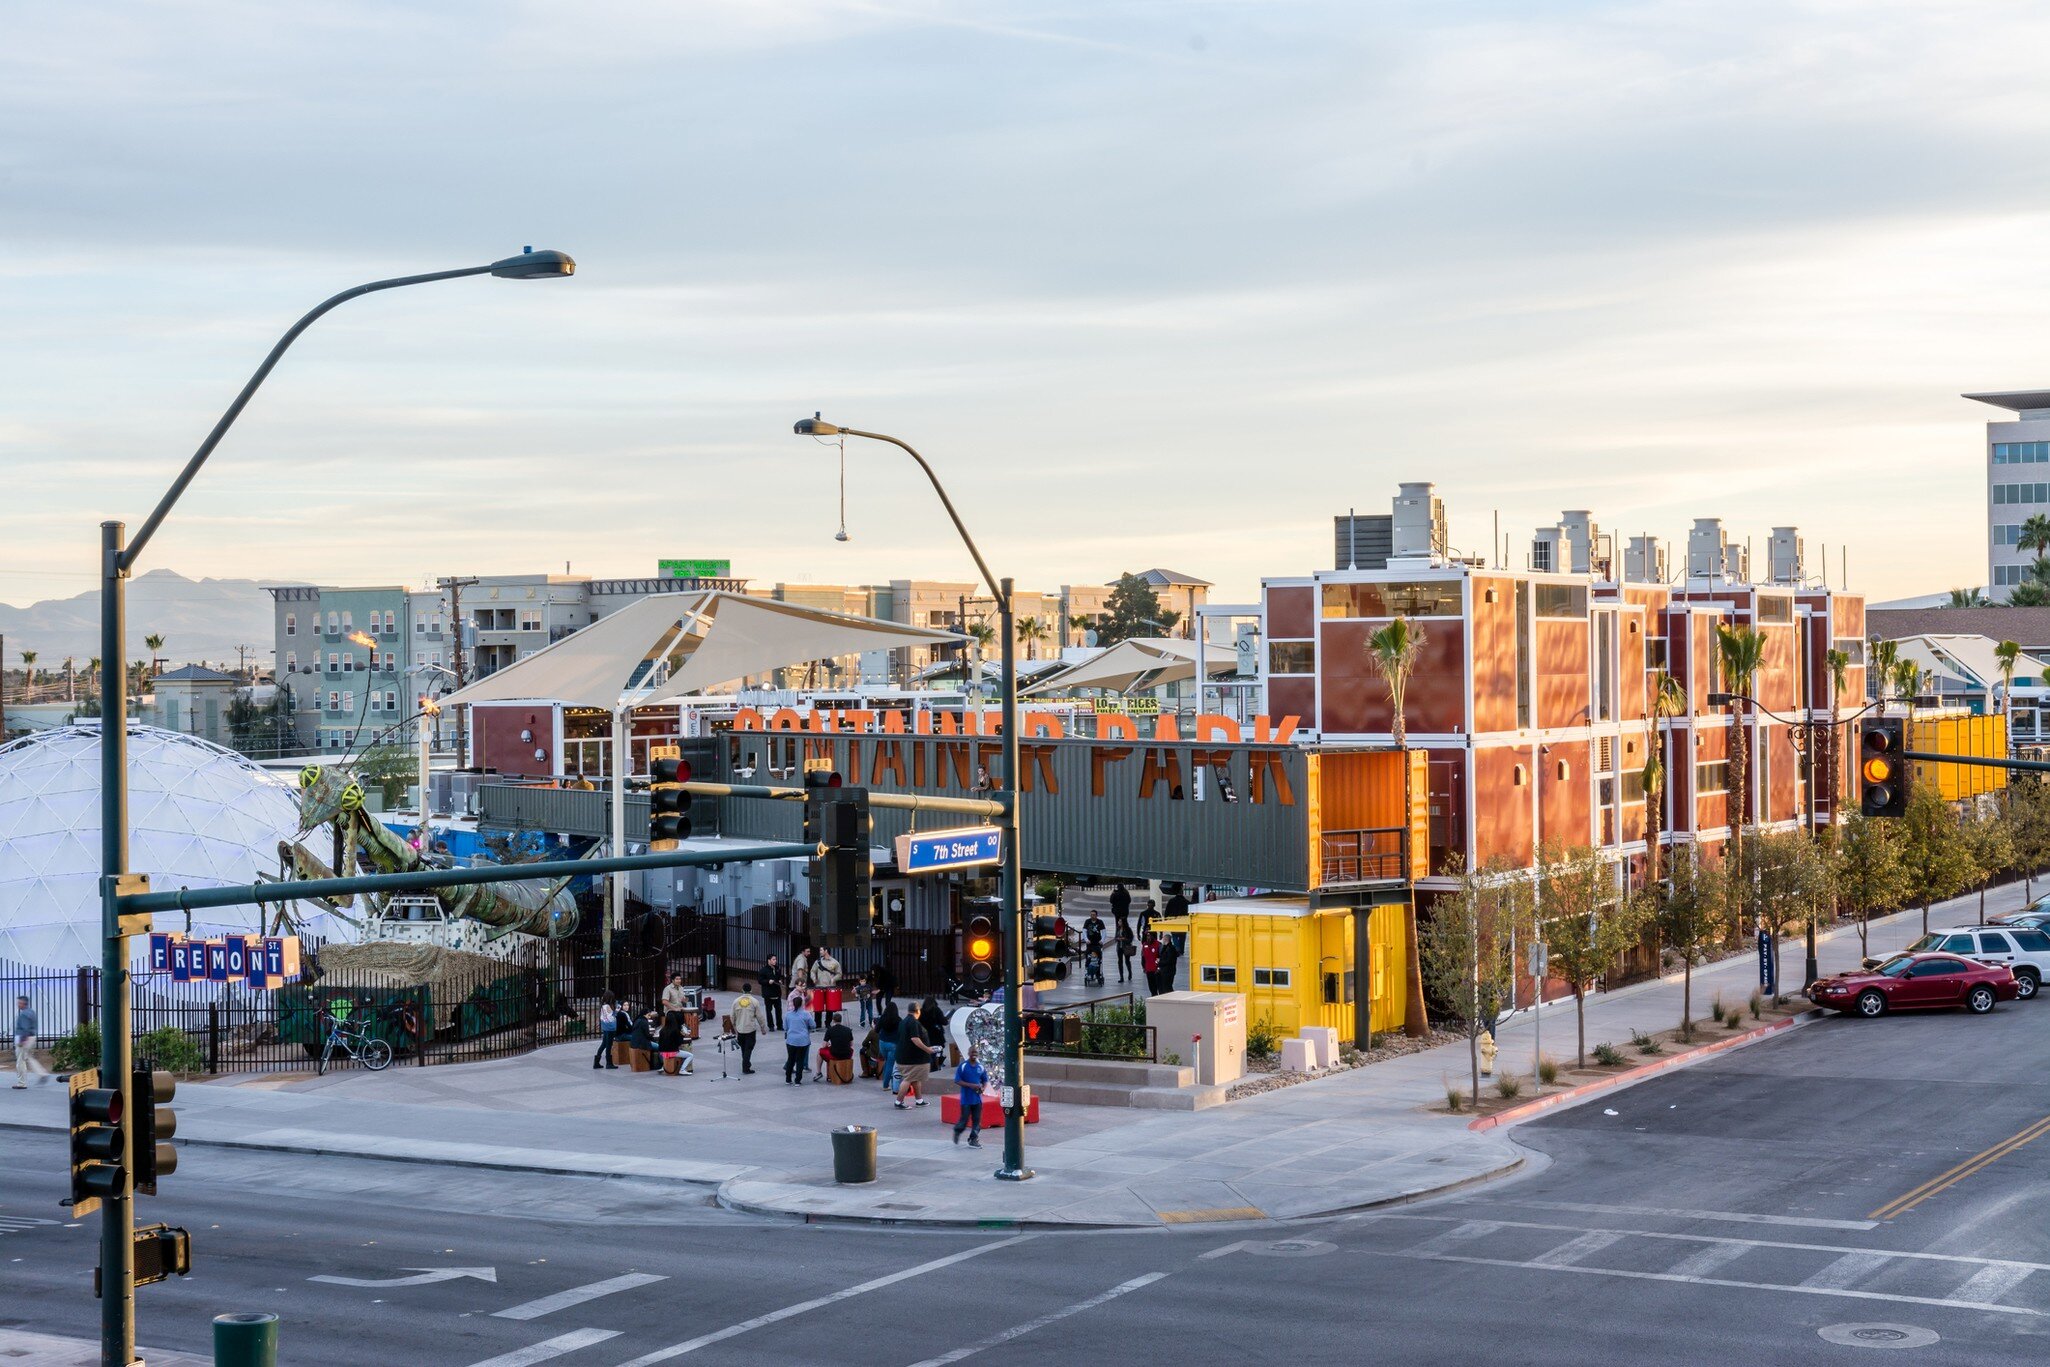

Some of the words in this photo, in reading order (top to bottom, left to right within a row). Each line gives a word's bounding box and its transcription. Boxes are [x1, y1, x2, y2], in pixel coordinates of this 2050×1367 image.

[1127, 699, 1157, 708] RICES
[730, 708, 1064, 794] CONTAINER
[1092, 714, 1301, 805] PARK
[913, 845, 918, 854] S
[934, 844, 948, 860] 7th
[951, 841, 978, 858] Street
[268, 941, 279, 950] ST.
[155, 949, 279, 972] FREMONT
